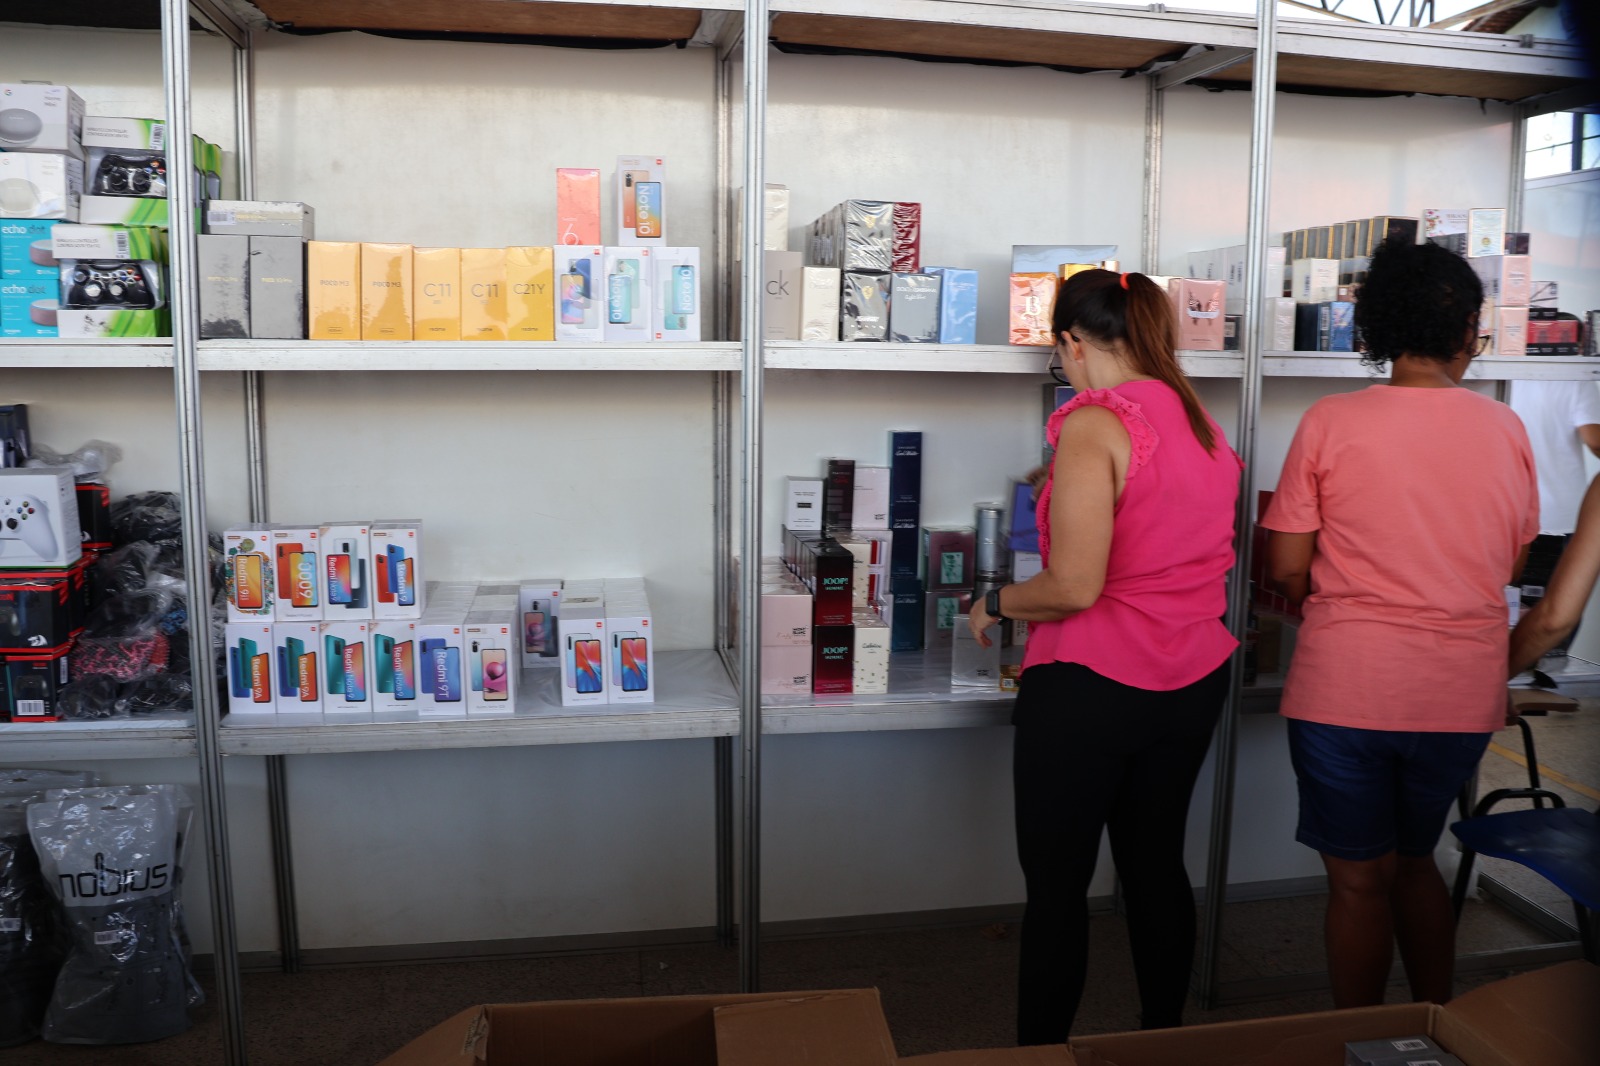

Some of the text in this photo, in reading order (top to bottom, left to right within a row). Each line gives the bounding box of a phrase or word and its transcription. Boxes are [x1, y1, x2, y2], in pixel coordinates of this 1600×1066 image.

[638, 185, 650, 235] Note 10
[2, 224, 46, 234] echo dot
[2, 284, 46, 294] echo dot
[423, 283, 451, 297] C11
[471, 283, 499, 298] C11
[513, 283, 545, 295] C21Y
[680, 269, 692, 311] Note 10
[766, 270, 789, 295] ck
[611, 309, 623, 320] 10
[239, 558, 249, 587] Redmi
[329, 557, 337, 580] Redmi
[300, 657, 309, 686] Redmi
[344, 648, 353, 674] Redmi
[394, 646, 402, 672] Redmi
[252, 658, 261, 687] Redmi
[437, 651, 449, 698] Redmi 9T
